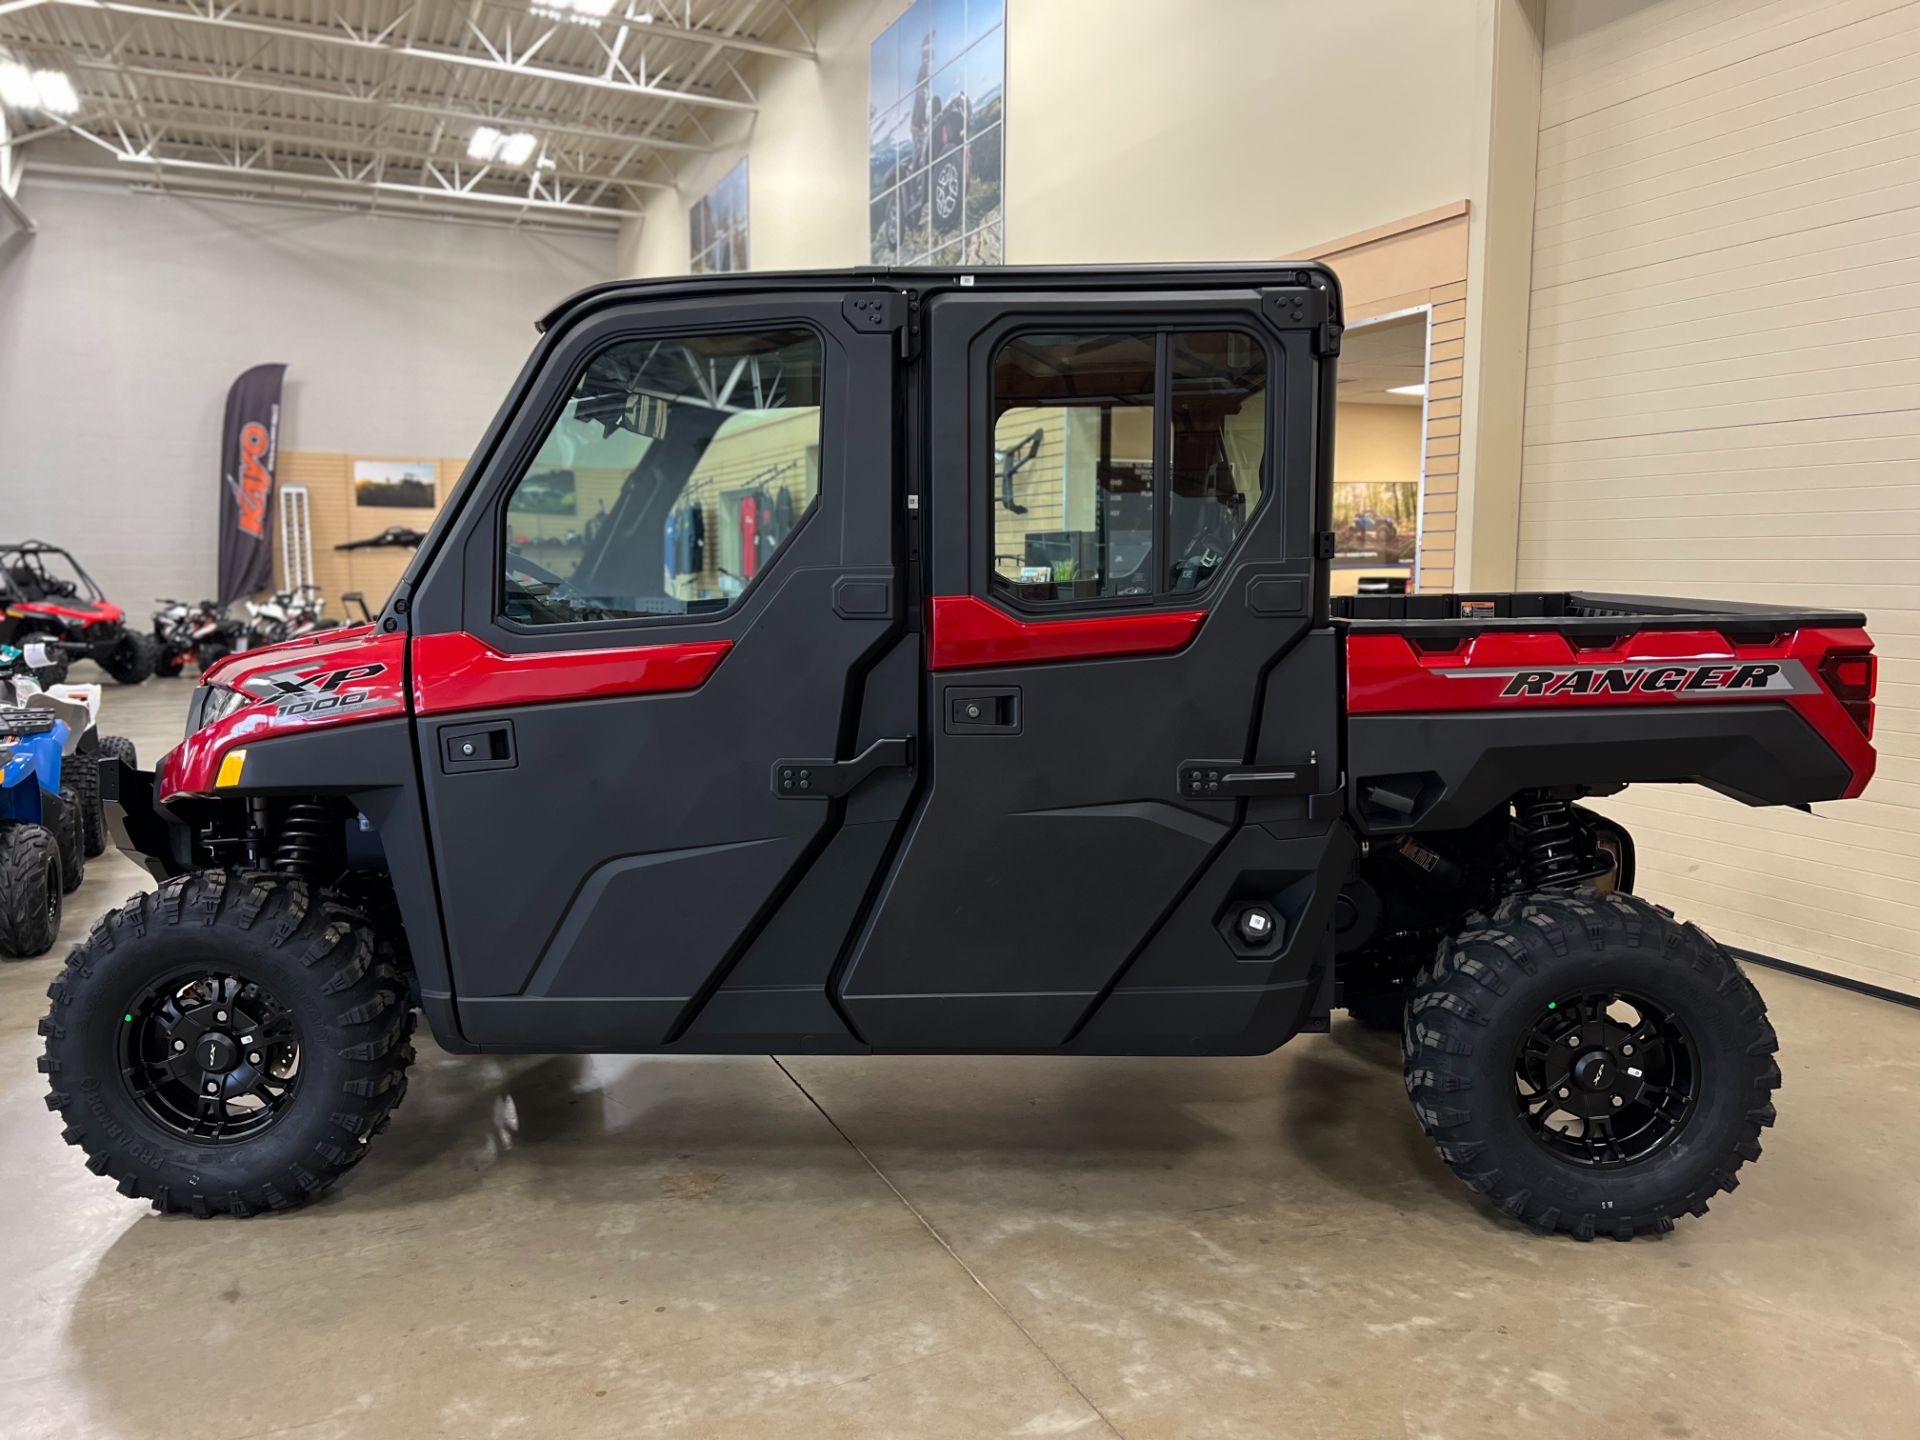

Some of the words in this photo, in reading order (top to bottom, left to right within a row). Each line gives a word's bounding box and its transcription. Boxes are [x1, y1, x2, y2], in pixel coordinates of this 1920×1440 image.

[226, 421, 272, 540] KAYO
[256, 662, 388, 706] XP
[1500, 664, 1781, 697] RANGER
[277, 692, 368, 717] 1000
